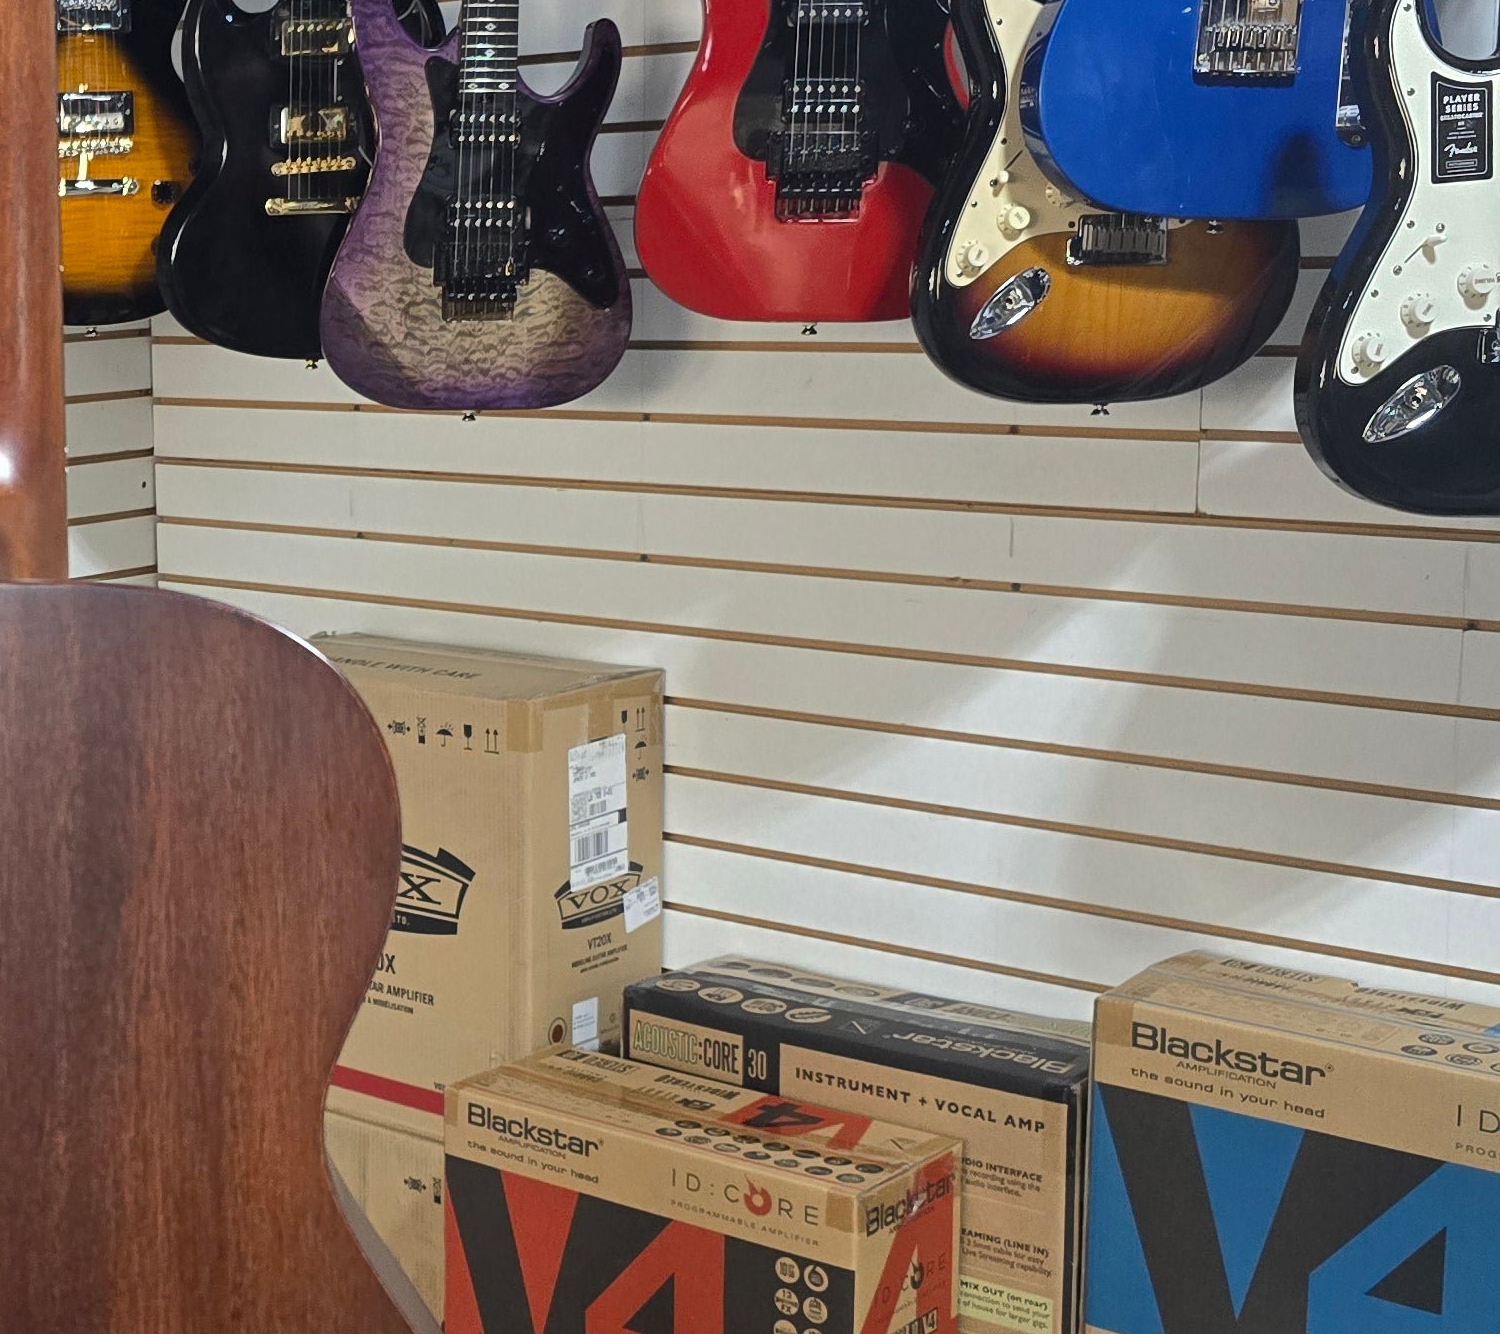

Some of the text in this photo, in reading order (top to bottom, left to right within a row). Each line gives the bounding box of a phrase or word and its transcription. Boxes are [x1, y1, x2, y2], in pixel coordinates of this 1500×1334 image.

[1442, 92, 1481, 105] PLAYER
[1444, 102, 1479, 114] SERIES
[568, 878, 631, 910] VOX
[386, 983, 435, 1007] AMPLIFIER
[747, 1048, 768, 1081] 30
[891, 1031, 1077, 1075] Blackstar
[1131, 1021, 1326, 1086] Blackstar
[1176, 1060, 1277, 1090] AMPLIFICATION
[795, 1067, 911, 1104] INSTRUMENT
[934, 1097, 997, 1124] VOCAL
[1003, 1114, 1046, 1133] AMP
[1130, 1067, 1326, 1119] the sound in your head
[467, 1102, 599, 1157] Blackstar
[467, 1139, 600, 1184] the sound in your head
[985, 1162, 1043, 1183] INTERFACE
[960, 1279, 980, 1292] MIX
[981, 1285, 1005, 1298] OUT
